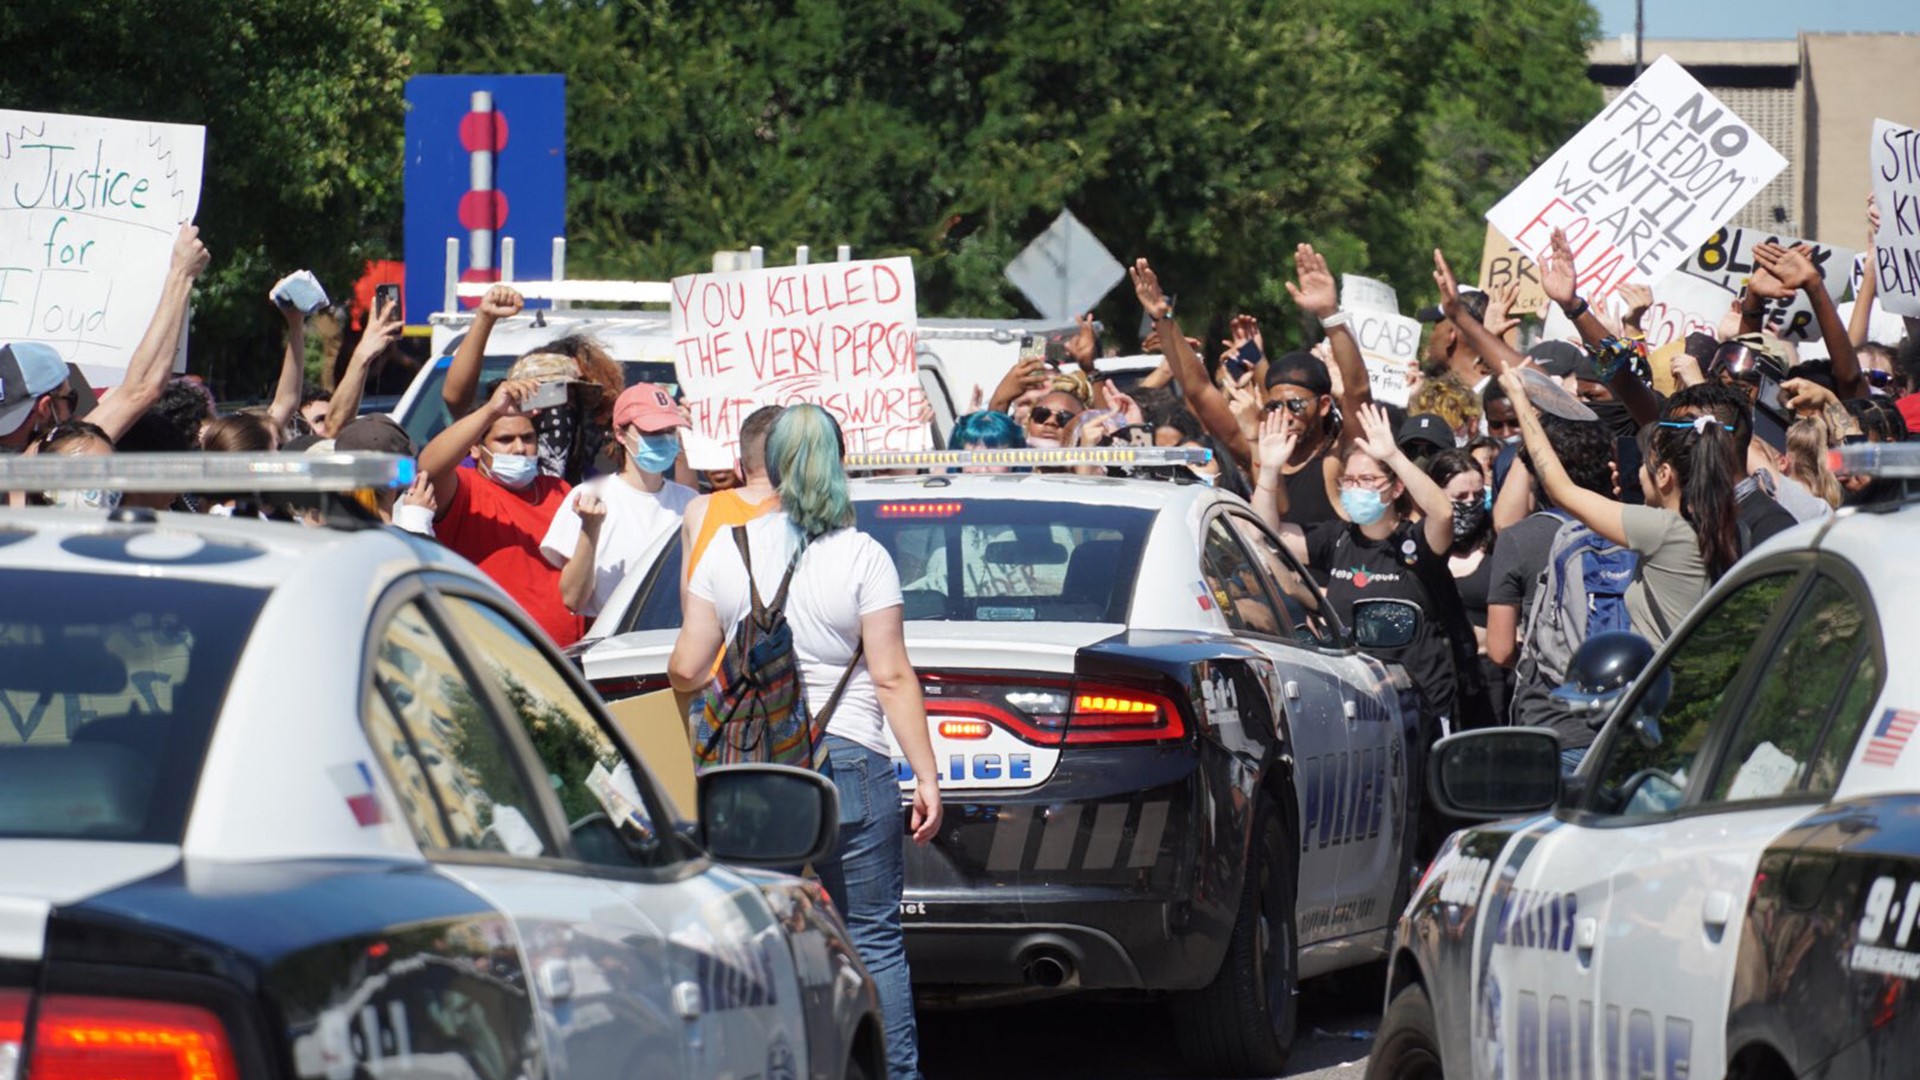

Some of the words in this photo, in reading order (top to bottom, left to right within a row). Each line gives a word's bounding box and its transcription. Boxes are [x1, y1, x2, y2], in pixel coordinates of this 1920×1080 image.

[1673, 92, 1749, 158] NO
[15, 139, 149, 210] Justice
[1588, 137, 1697, 252] UNTIL
[44, 216, 95, 267] for
[1554, 161, 1609, 214] WE
[1595, 206, 1671, 276] ARE
[1698, 227, 1832, 281] BLK
[0, 267, 114, 360] Floyd
[671, 274, 745, 331] YOU
[767, 265, 900, 317] KILLED
[675, 331, 734, 379] THE
[745, 322, 828, 379] VERY
[832, 320, 917, 381] PERSON
[655, 392, 668, 406] B
[825, 387, 923, 425] SWORE
